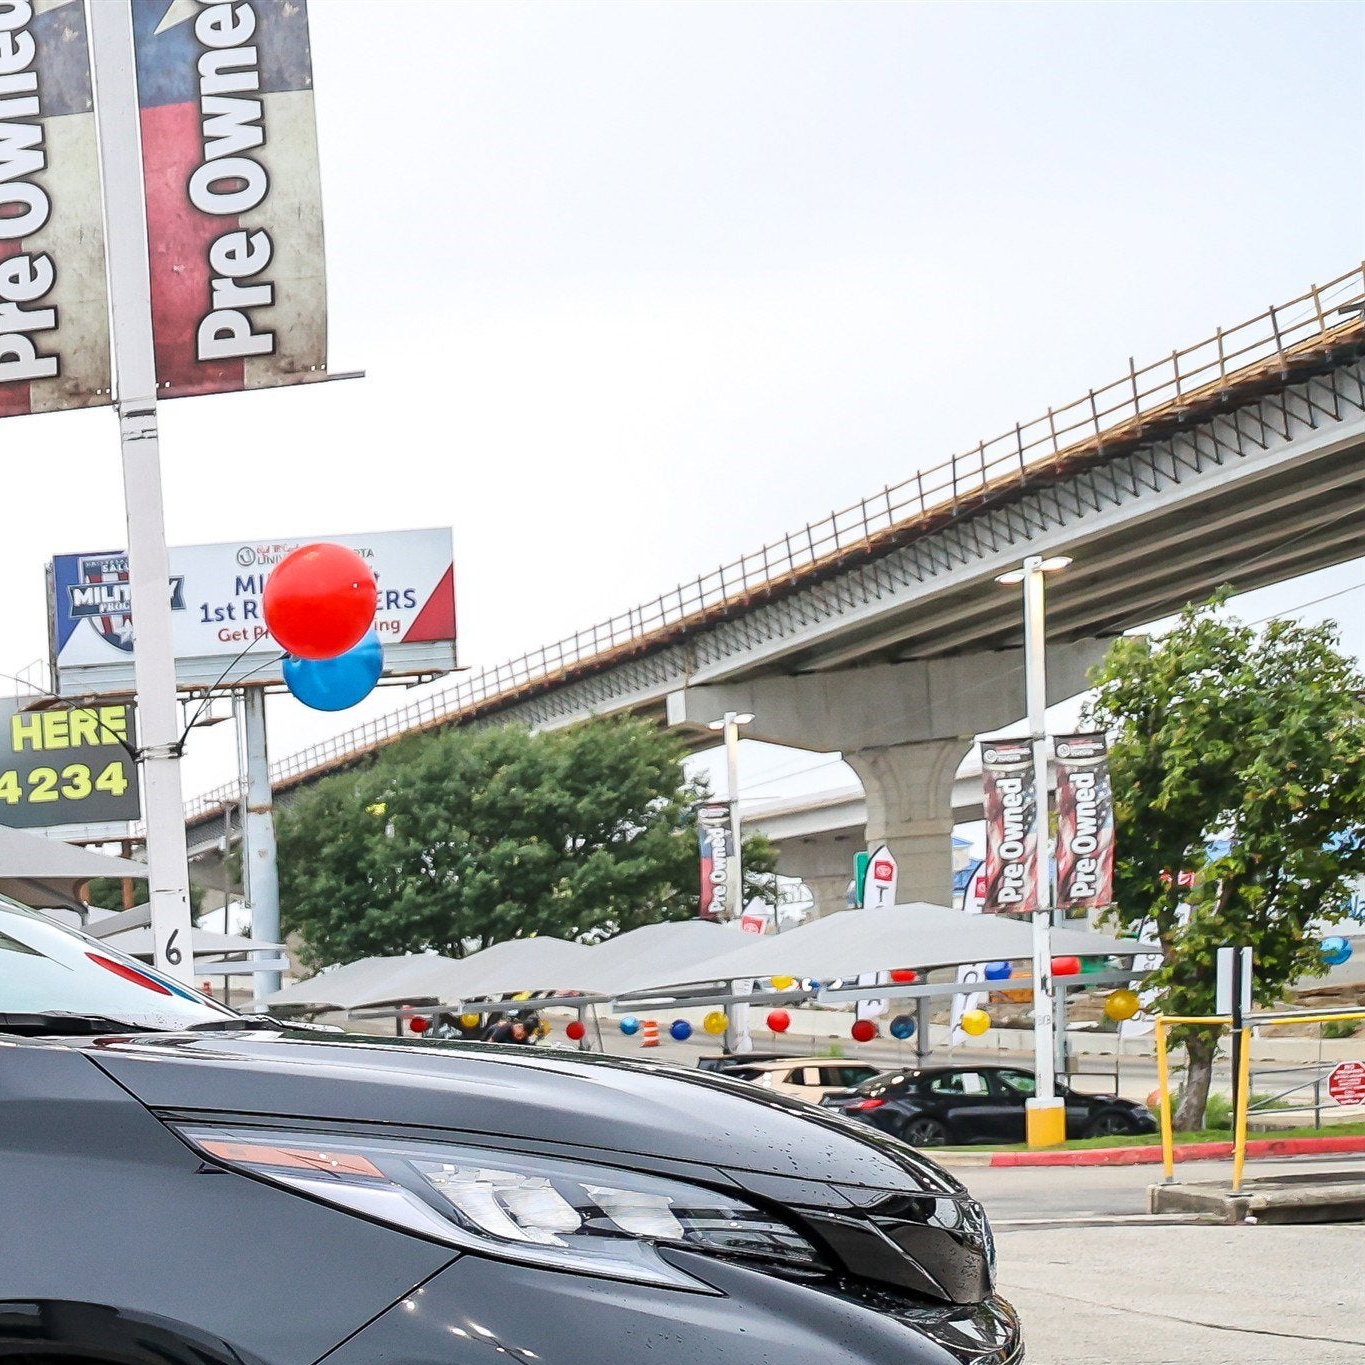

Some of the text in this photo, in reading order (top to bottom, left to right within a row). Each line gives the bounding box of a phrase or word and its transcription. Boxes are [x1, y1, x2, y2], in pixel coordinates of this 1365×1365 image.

[188, 0, 274, 362] Pre Owne
[200, 602, 236, 623] 1st
[218, 628, 248, 642] Get
[12, 706, 127, 752] HERE
[996, 777, 1025, 860] Owned
[1069, 772, 1098, 853] Owned
[998, 862, 1025, 903] Pre
[1070, 857, 1097, 898] Pre
[165, 928, 182, 966] 6
